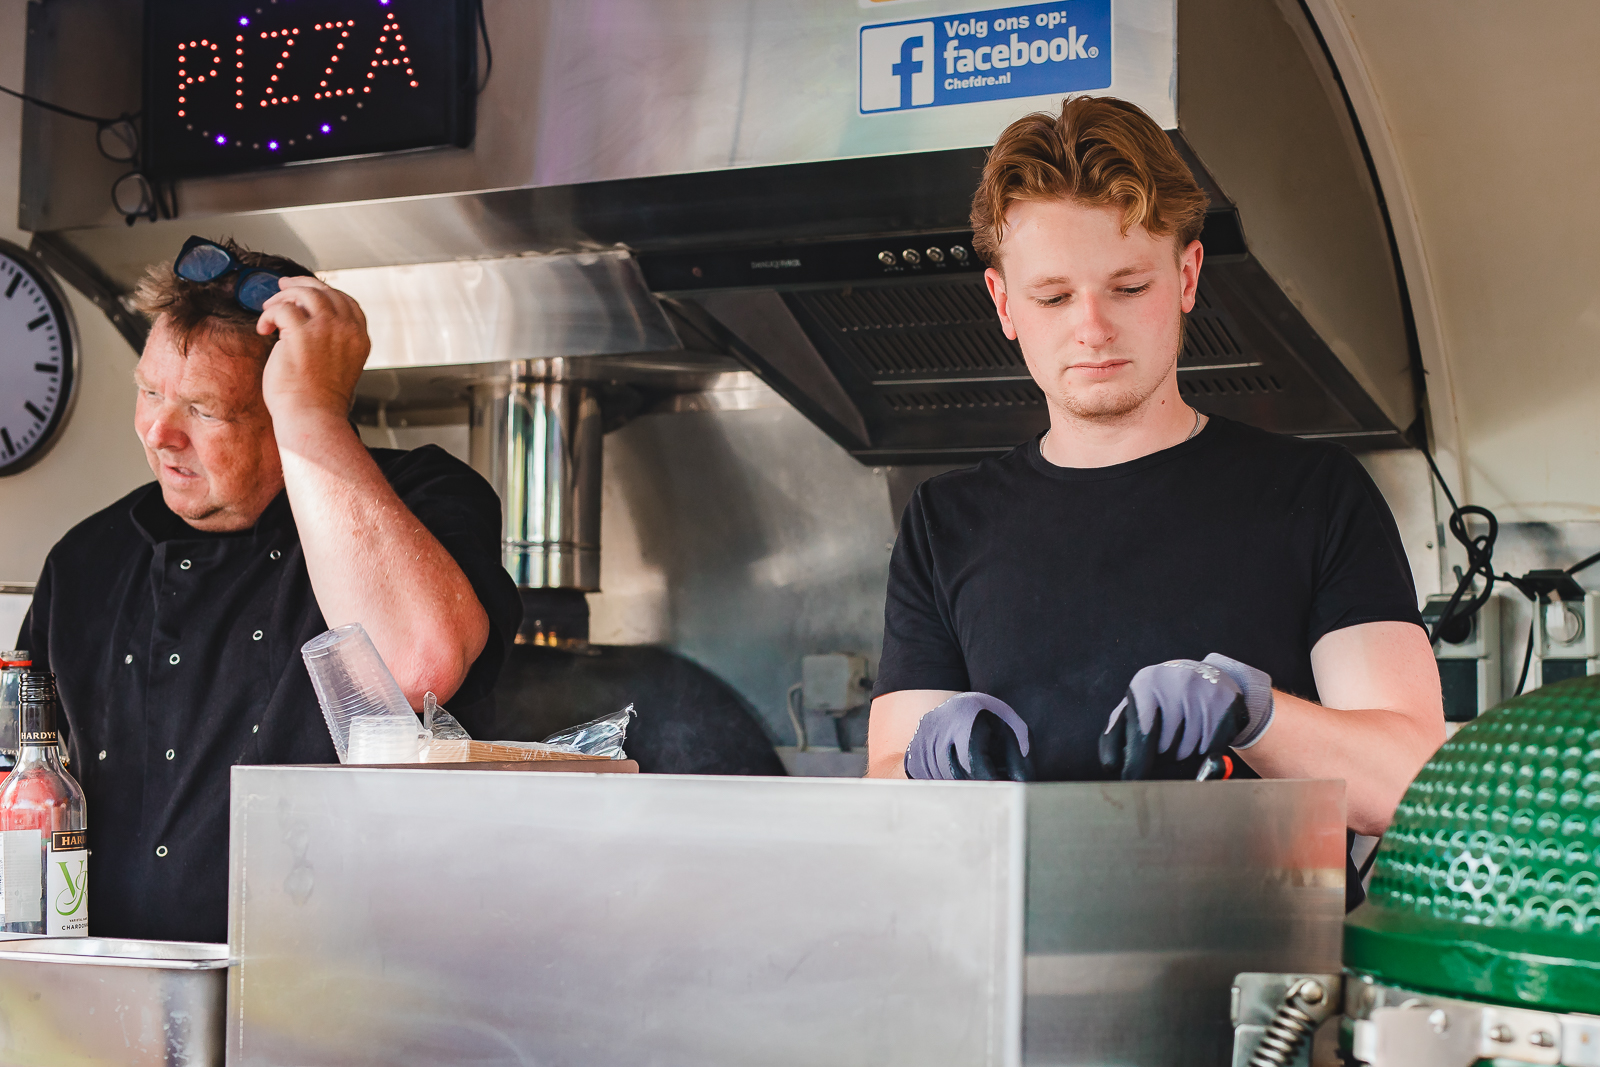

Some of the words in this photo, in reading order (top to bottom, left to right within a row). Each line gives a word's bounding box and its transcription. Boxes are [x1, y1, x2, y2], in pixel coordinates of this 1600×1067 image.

[944, 19, 988, 38] Volg
[993, 15, 1030, 32] ons
[1036, 11, 1067, 29] op:
[178, 12, 418, 117] PIZZA
[944, 72, 1011, 91] Chefdre.nl
